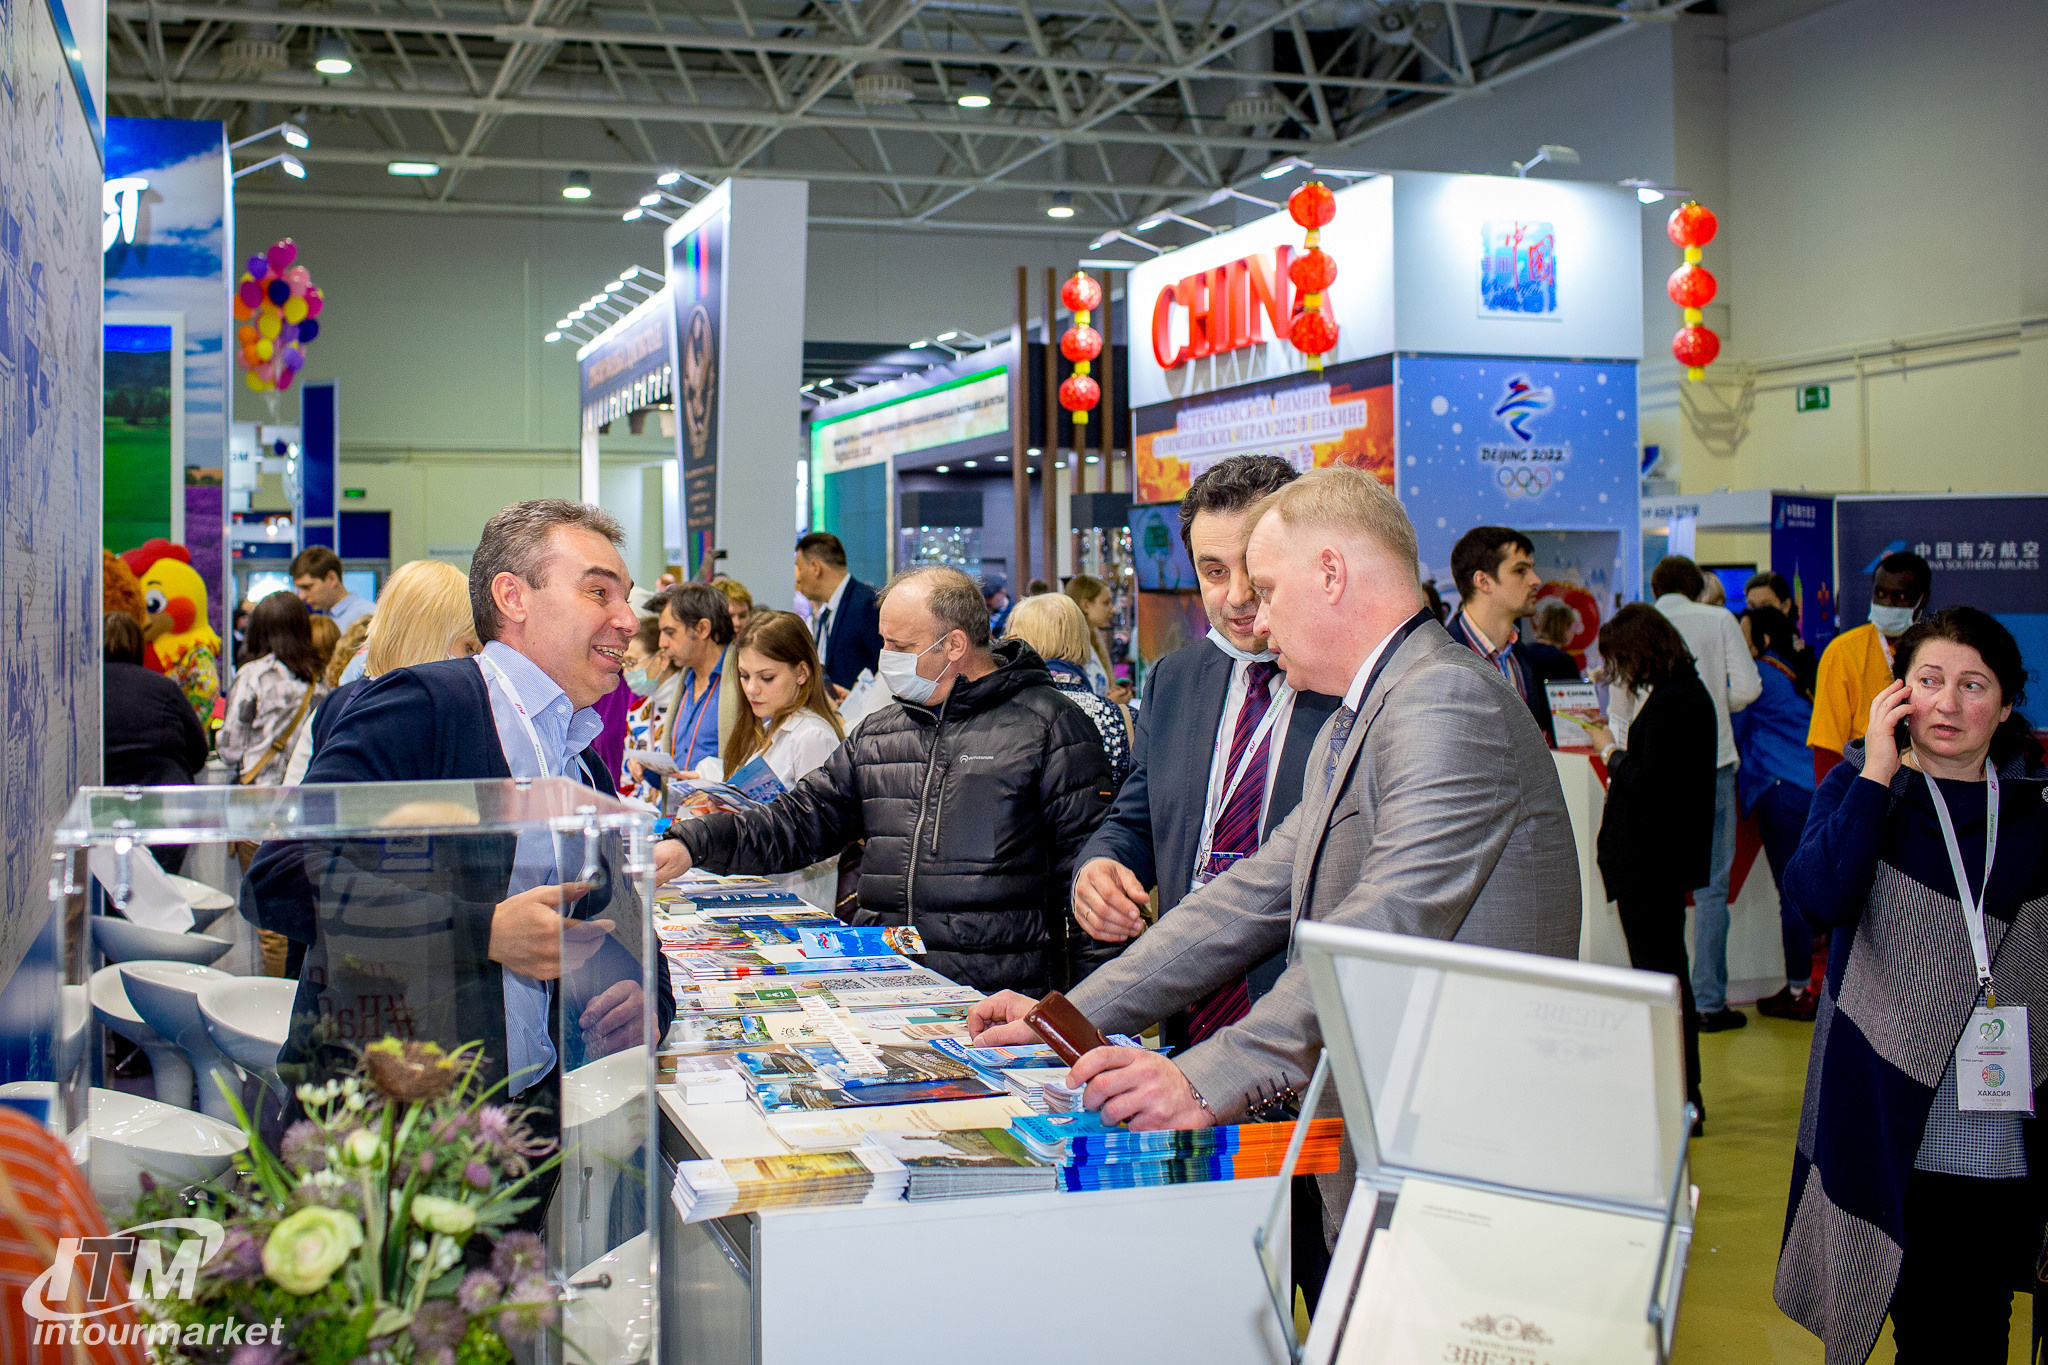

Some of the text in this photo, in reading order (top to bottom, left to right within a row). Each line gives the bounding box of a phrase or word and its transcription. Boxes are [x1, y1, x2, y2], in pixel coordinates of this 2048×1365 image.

[1481, 447, 1565, 464] BEIJING 2022
[1914, 540, 2040, 559] 中国南方航空
[1946, 560, 1996, 571] SOUTHERN
[1998, 559, 2040, 570] AIRLINES
